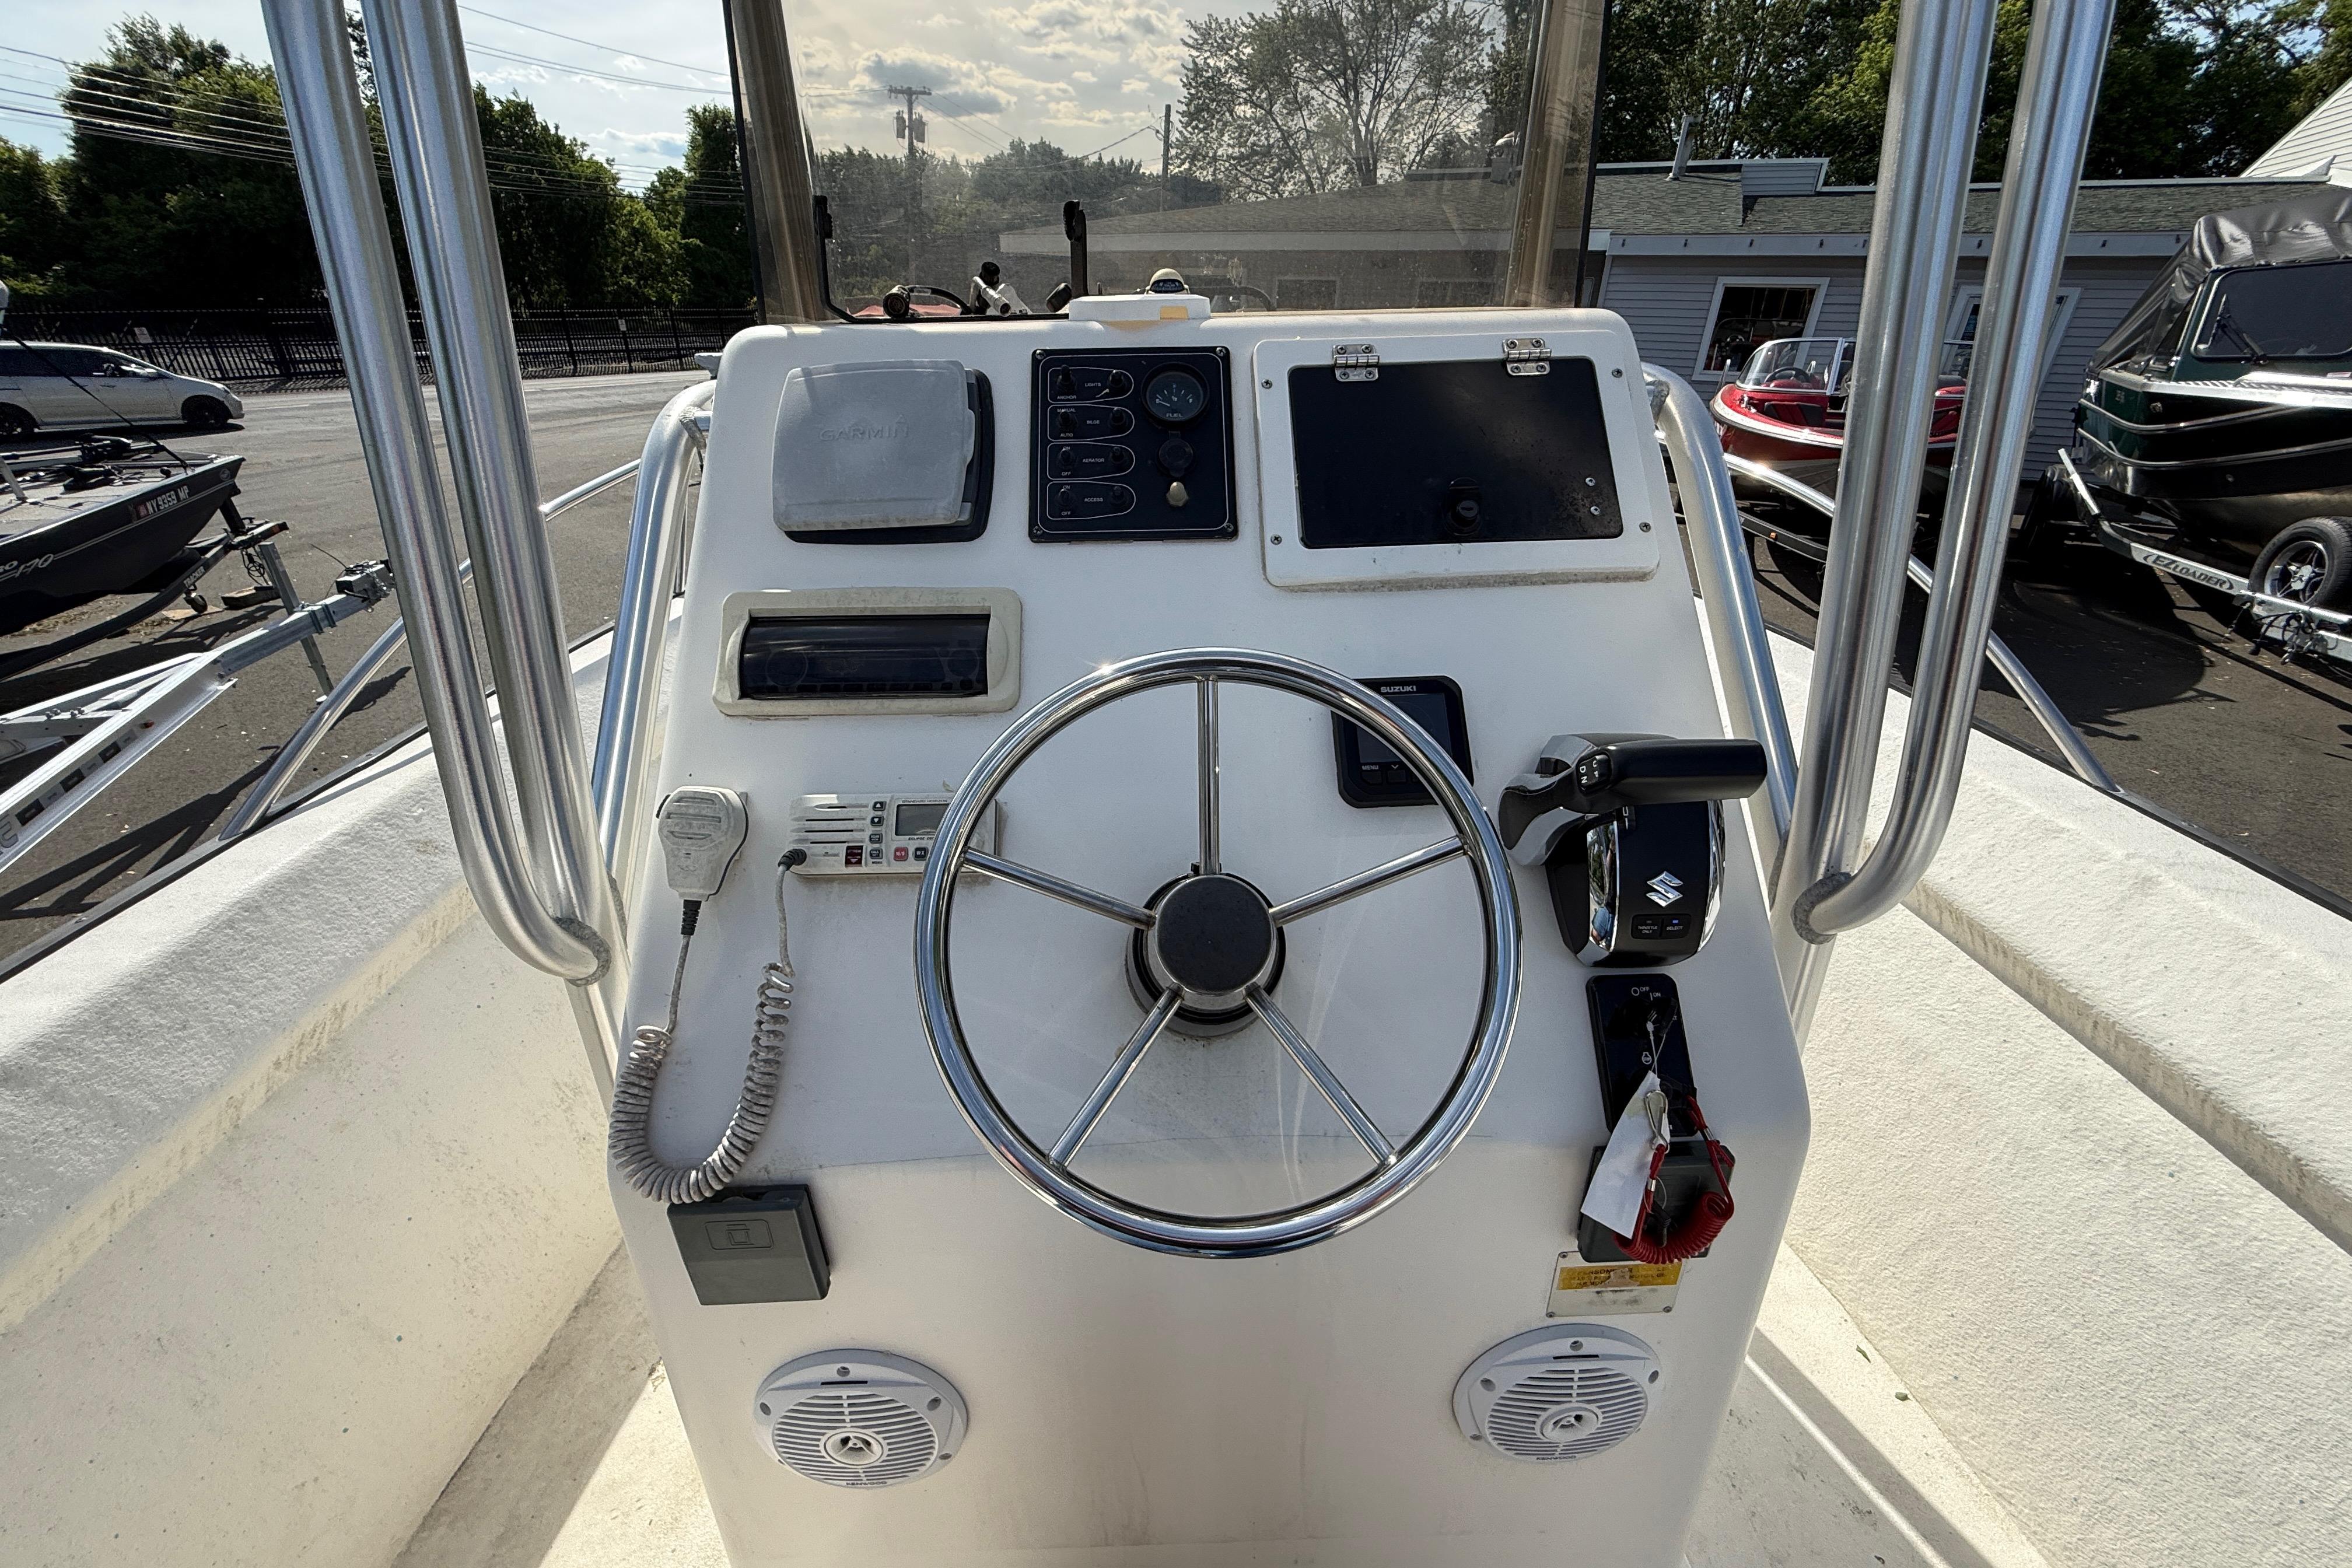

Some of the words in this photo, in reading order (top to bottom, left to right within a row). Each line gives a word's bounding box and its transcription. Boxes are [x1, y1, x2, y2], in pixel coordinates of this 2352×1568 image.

[819, 424, 909, 442] GARMIN
[146, 498, 158, 514] NY
[156, 490, 178, 510] 9359
[177, 485, 189, 501] MP
[1580, 765, 1588, 783] DN
